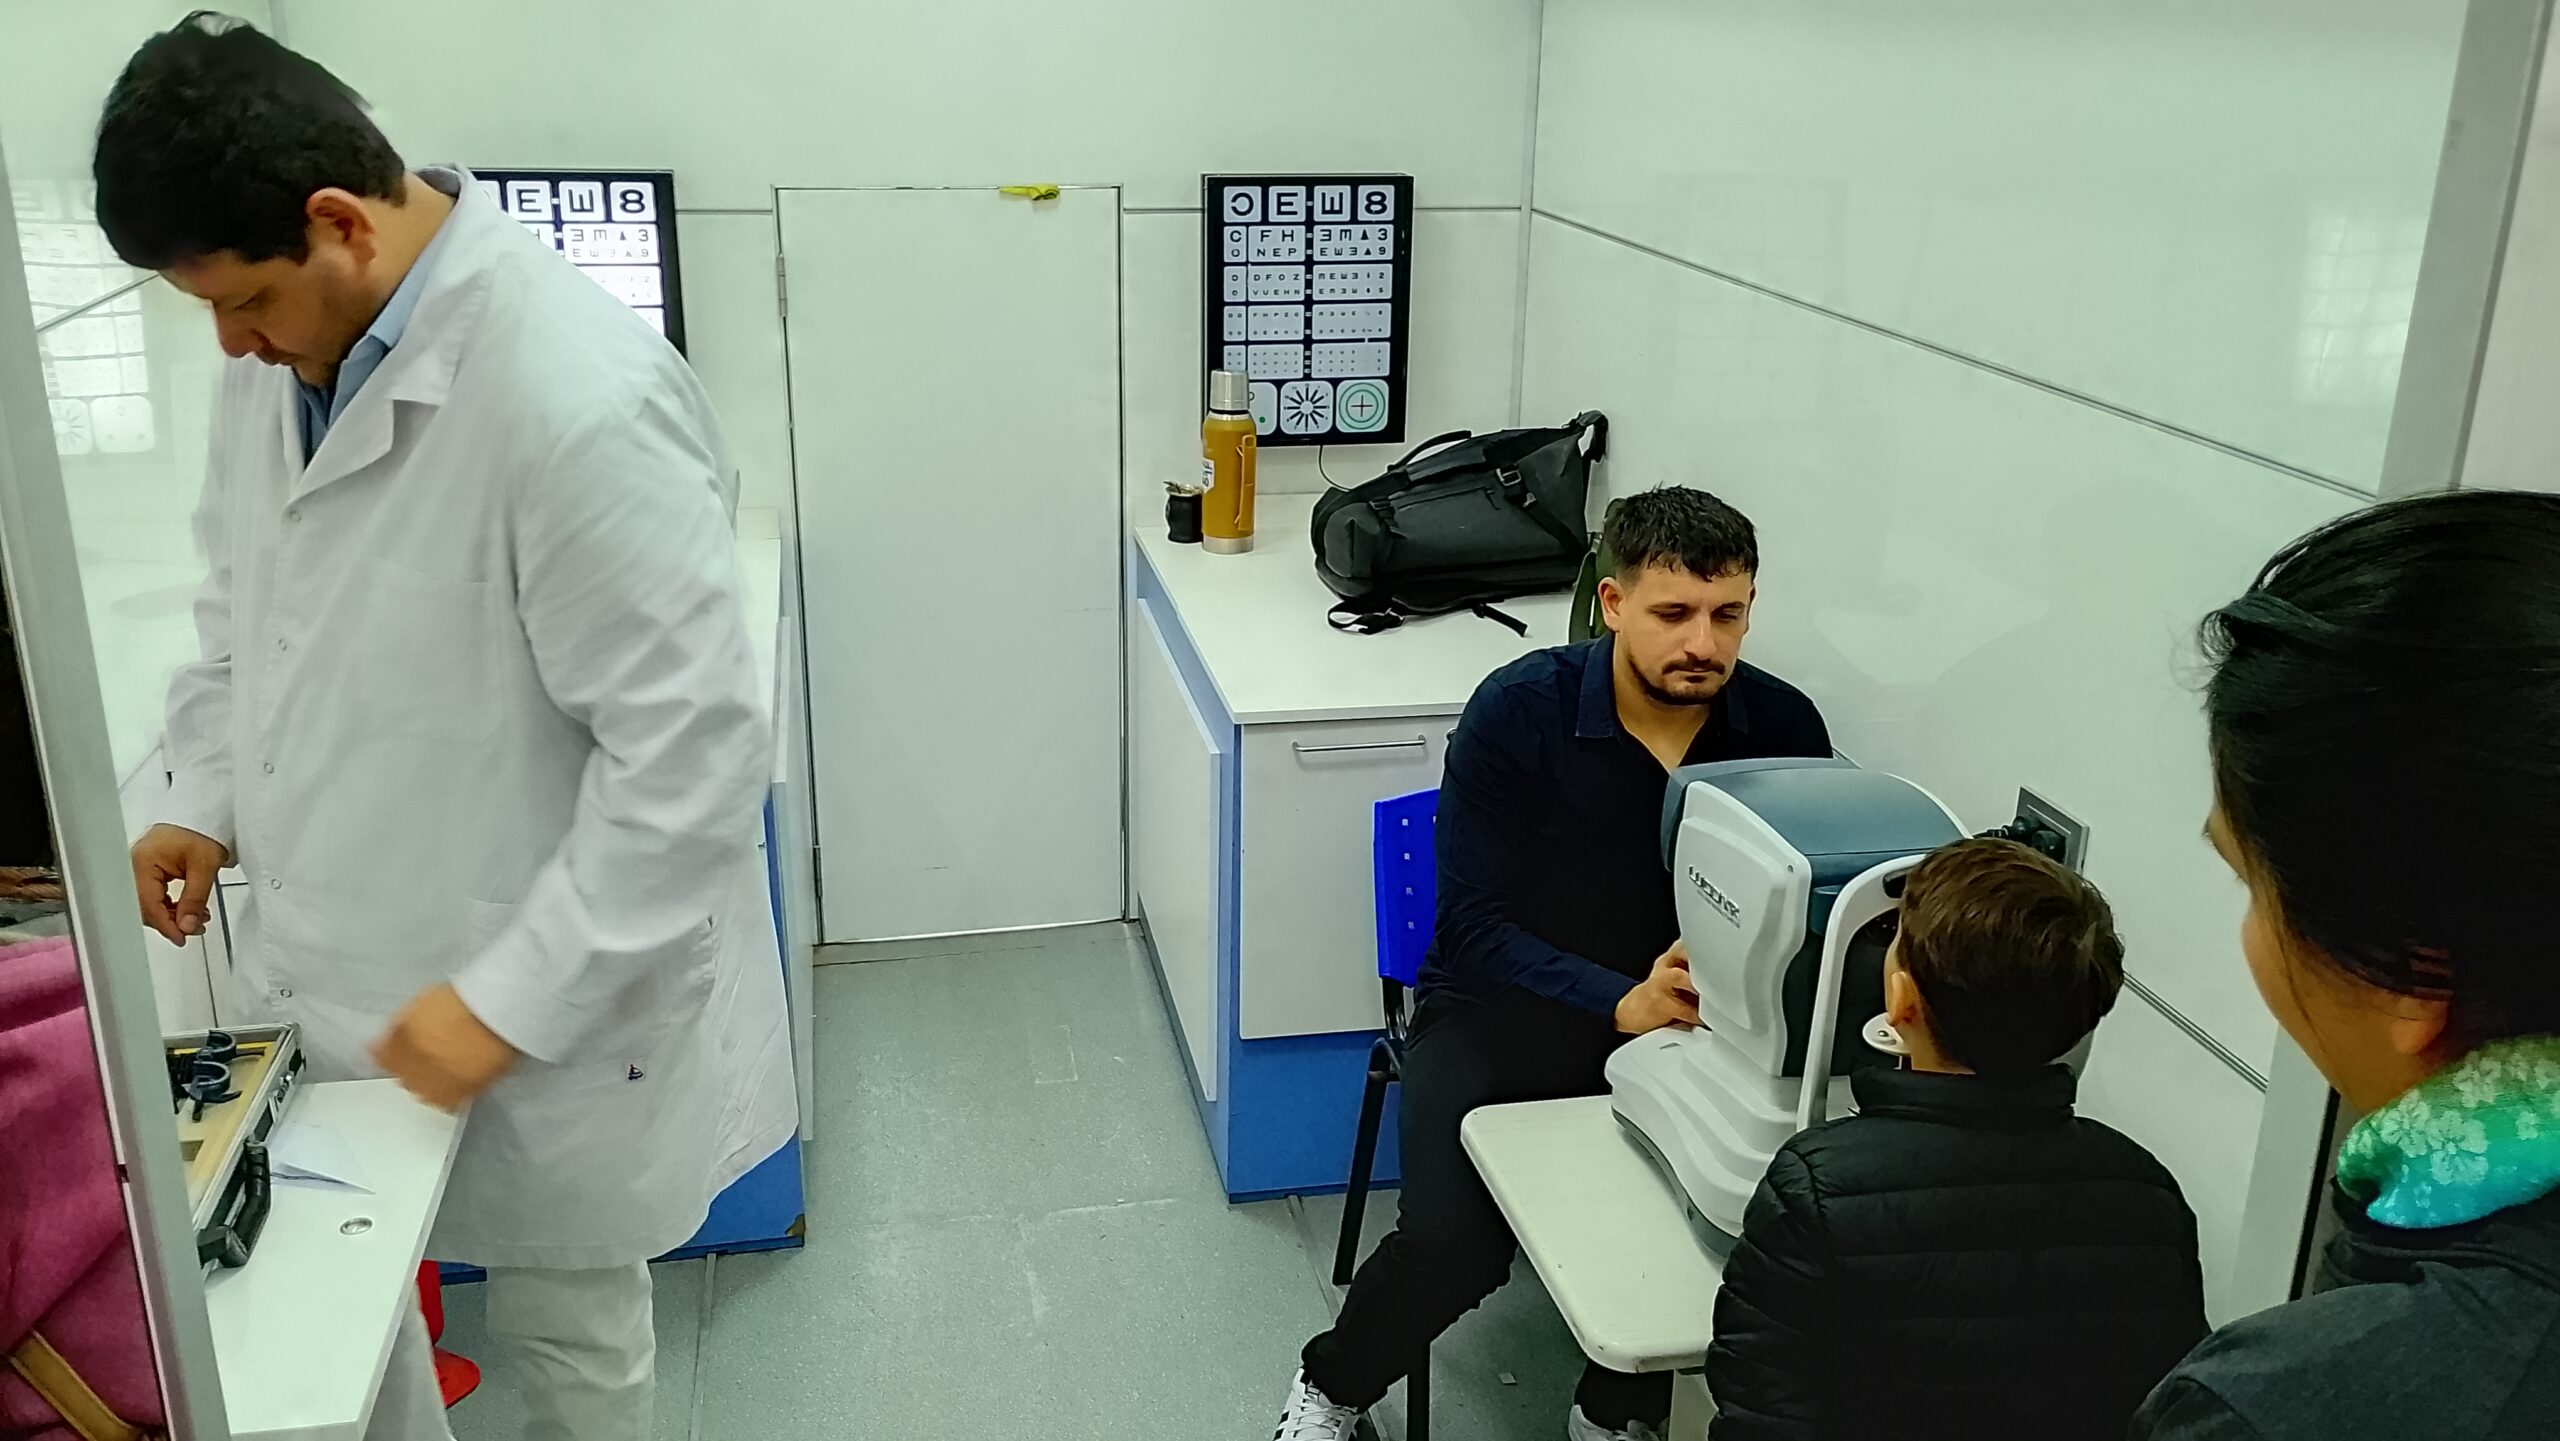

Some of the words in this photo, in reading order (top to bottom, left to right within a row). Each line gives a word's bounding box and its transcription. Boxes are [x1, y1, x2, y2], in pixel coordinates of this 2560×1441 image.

[517, 189, 541, 212] E
[620, 190, 645, 213] 8
[1277, 193, 1298, 215] E
[1365, 191, 1387, 214] 8
[639, 229, 648, 241] 3
[1230, 230, 1241, 242] C
[1261, 230, 1272, 242] F
[1282, 230, 1294, 242] H
[1378, 228, 1387, 240] 3
[1256, 248, 1266, 257] N
[1272, 247, 1282, 258] E
[1287, 247, 1297, 257] P
[1378, 246, 1387, 256] 9
